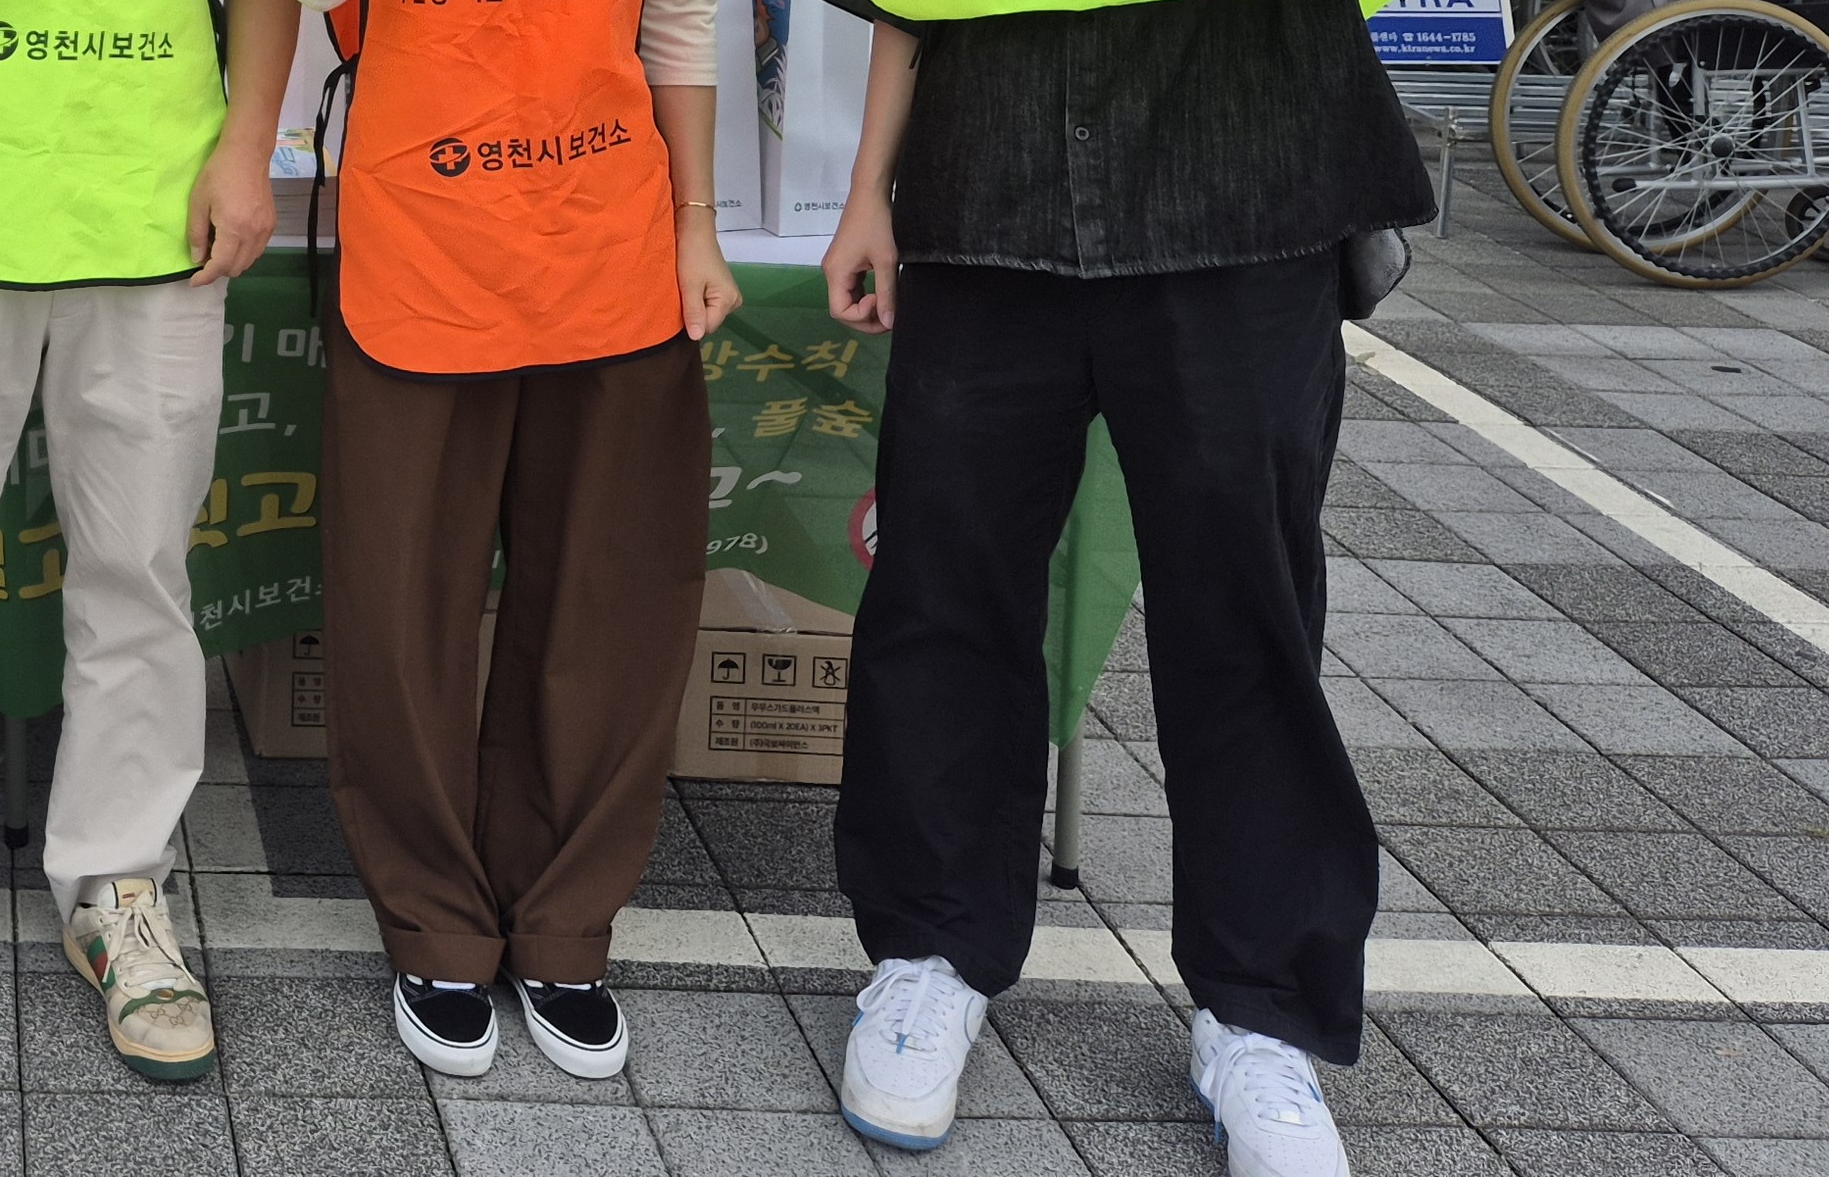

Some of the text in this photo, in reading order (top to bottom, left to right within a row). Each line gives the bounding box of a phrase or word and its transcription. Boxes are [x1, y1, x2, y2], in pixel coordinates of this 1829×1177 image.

[25, 30, 174, 61] 영천시보건소
[477, 119, 631, 171] 영천시보건소
[191, 576, 321, 630] 천시보건
